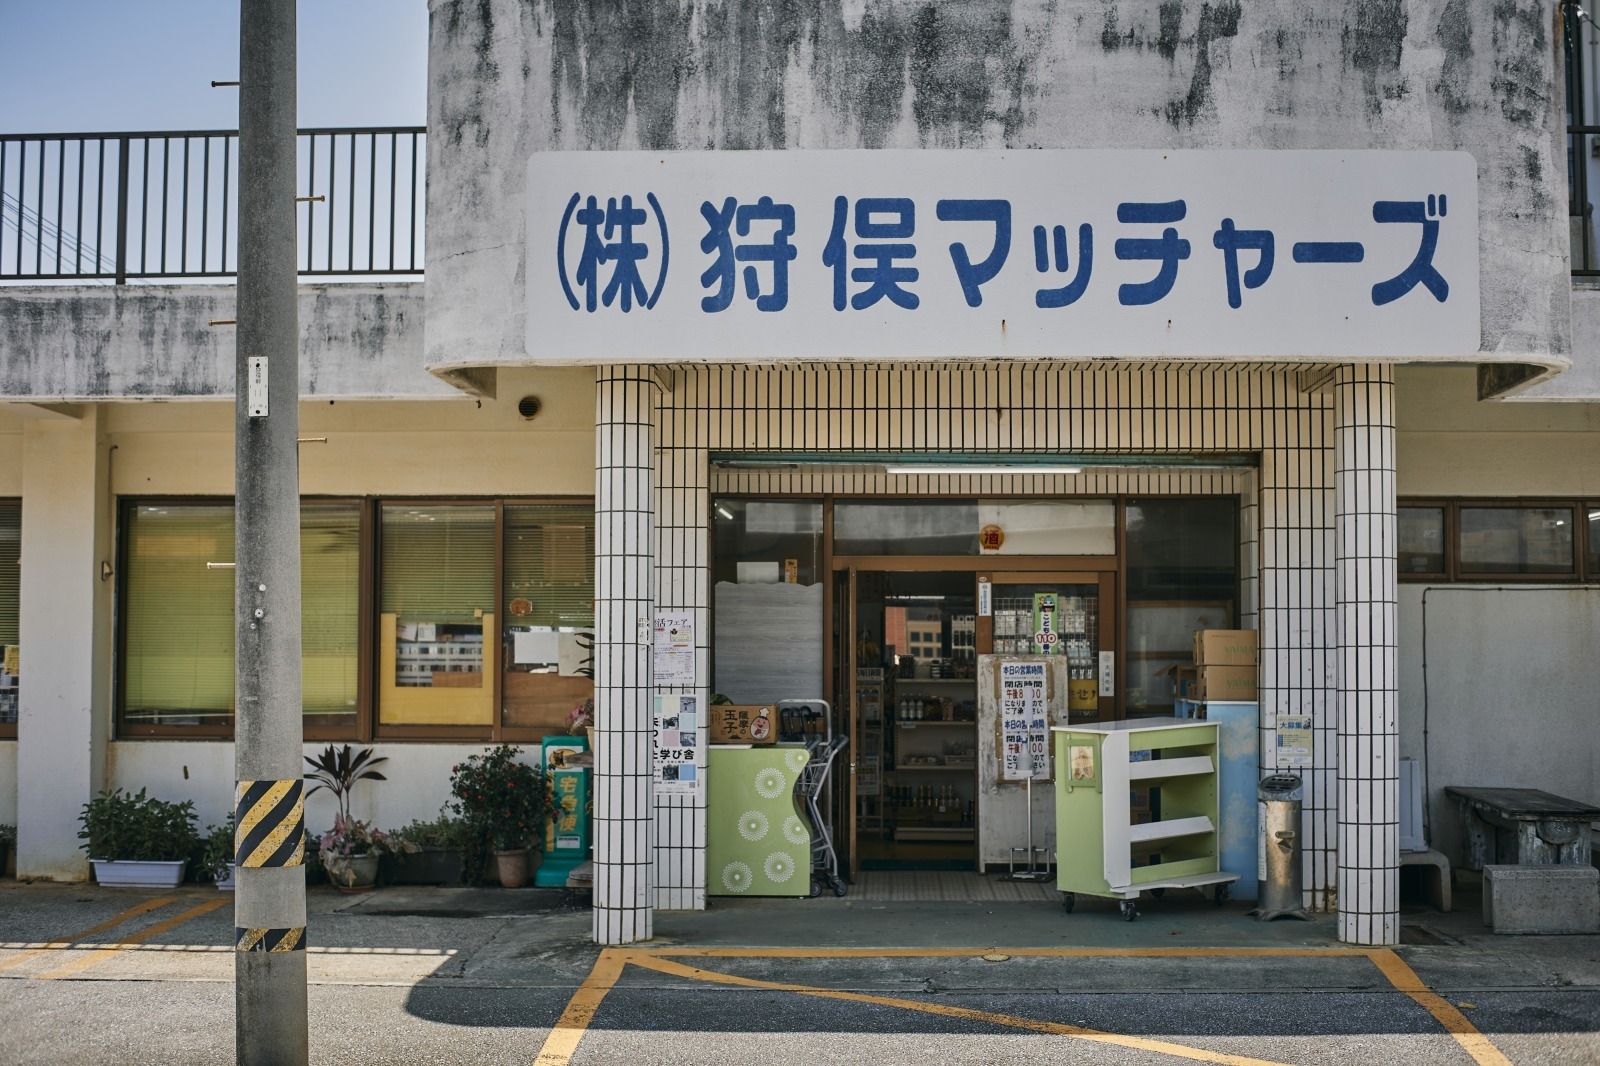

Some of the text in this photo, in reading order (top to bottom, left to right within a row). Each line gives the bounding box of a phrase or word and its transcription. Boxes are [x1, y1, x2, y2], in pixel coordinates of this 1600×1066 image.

[557, 191, 1449, 314] (株)狩俣マッチャーズ
[984, 529, 999, 545] 酒
[1003, 665, 1043, 675] 本日の営業時間
[723, 709, 738, 734] 玉子
